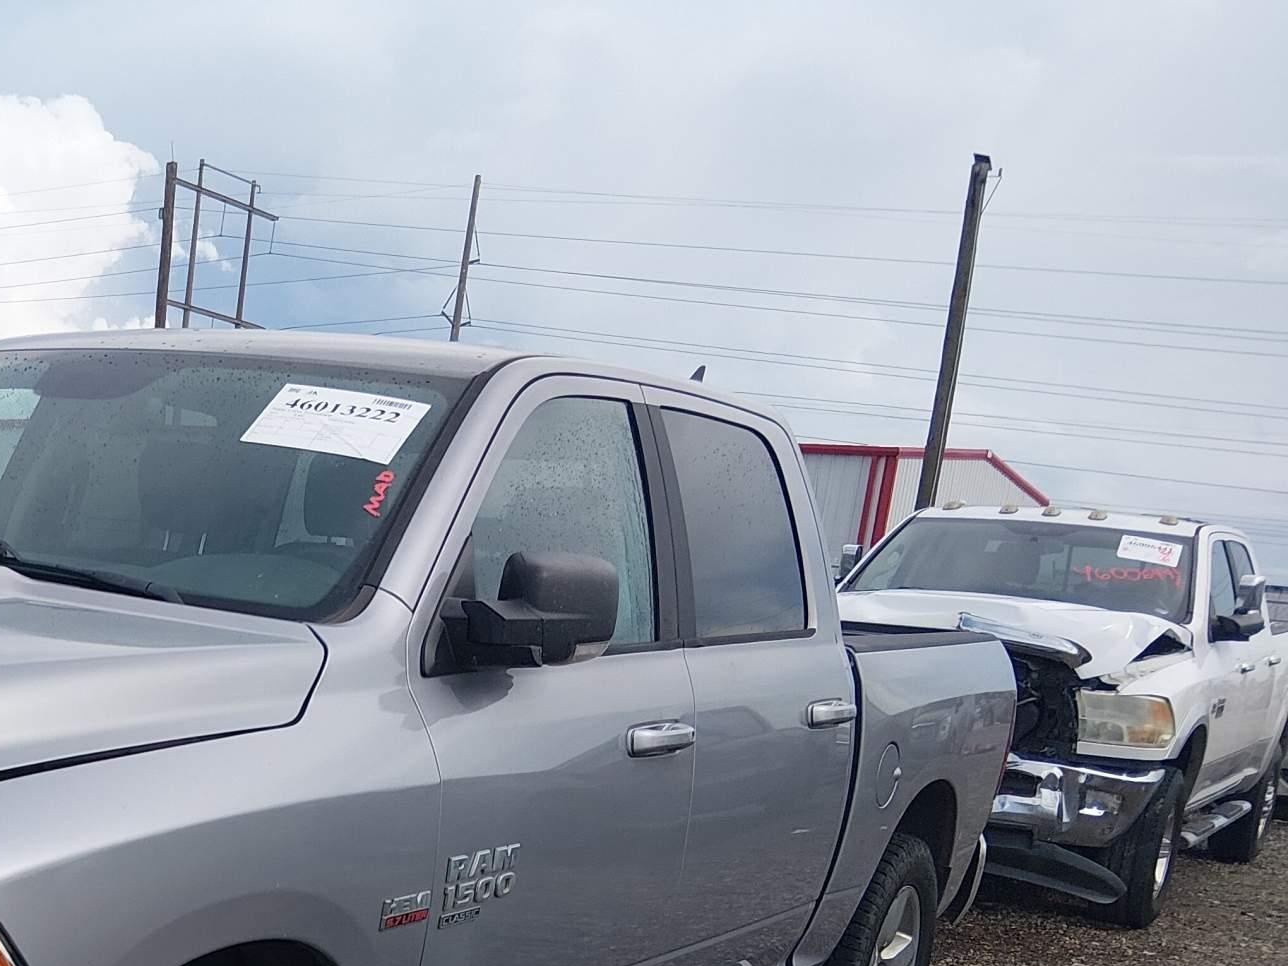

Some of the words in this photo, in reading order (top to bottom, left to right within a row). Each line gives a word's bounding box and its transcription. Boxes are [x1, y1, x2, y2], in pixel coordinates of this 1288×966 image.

[285, 398, 401, 423] 46013222
[445, 843, 520, 884] RAM
[441, 872, 515, 912] 1500
